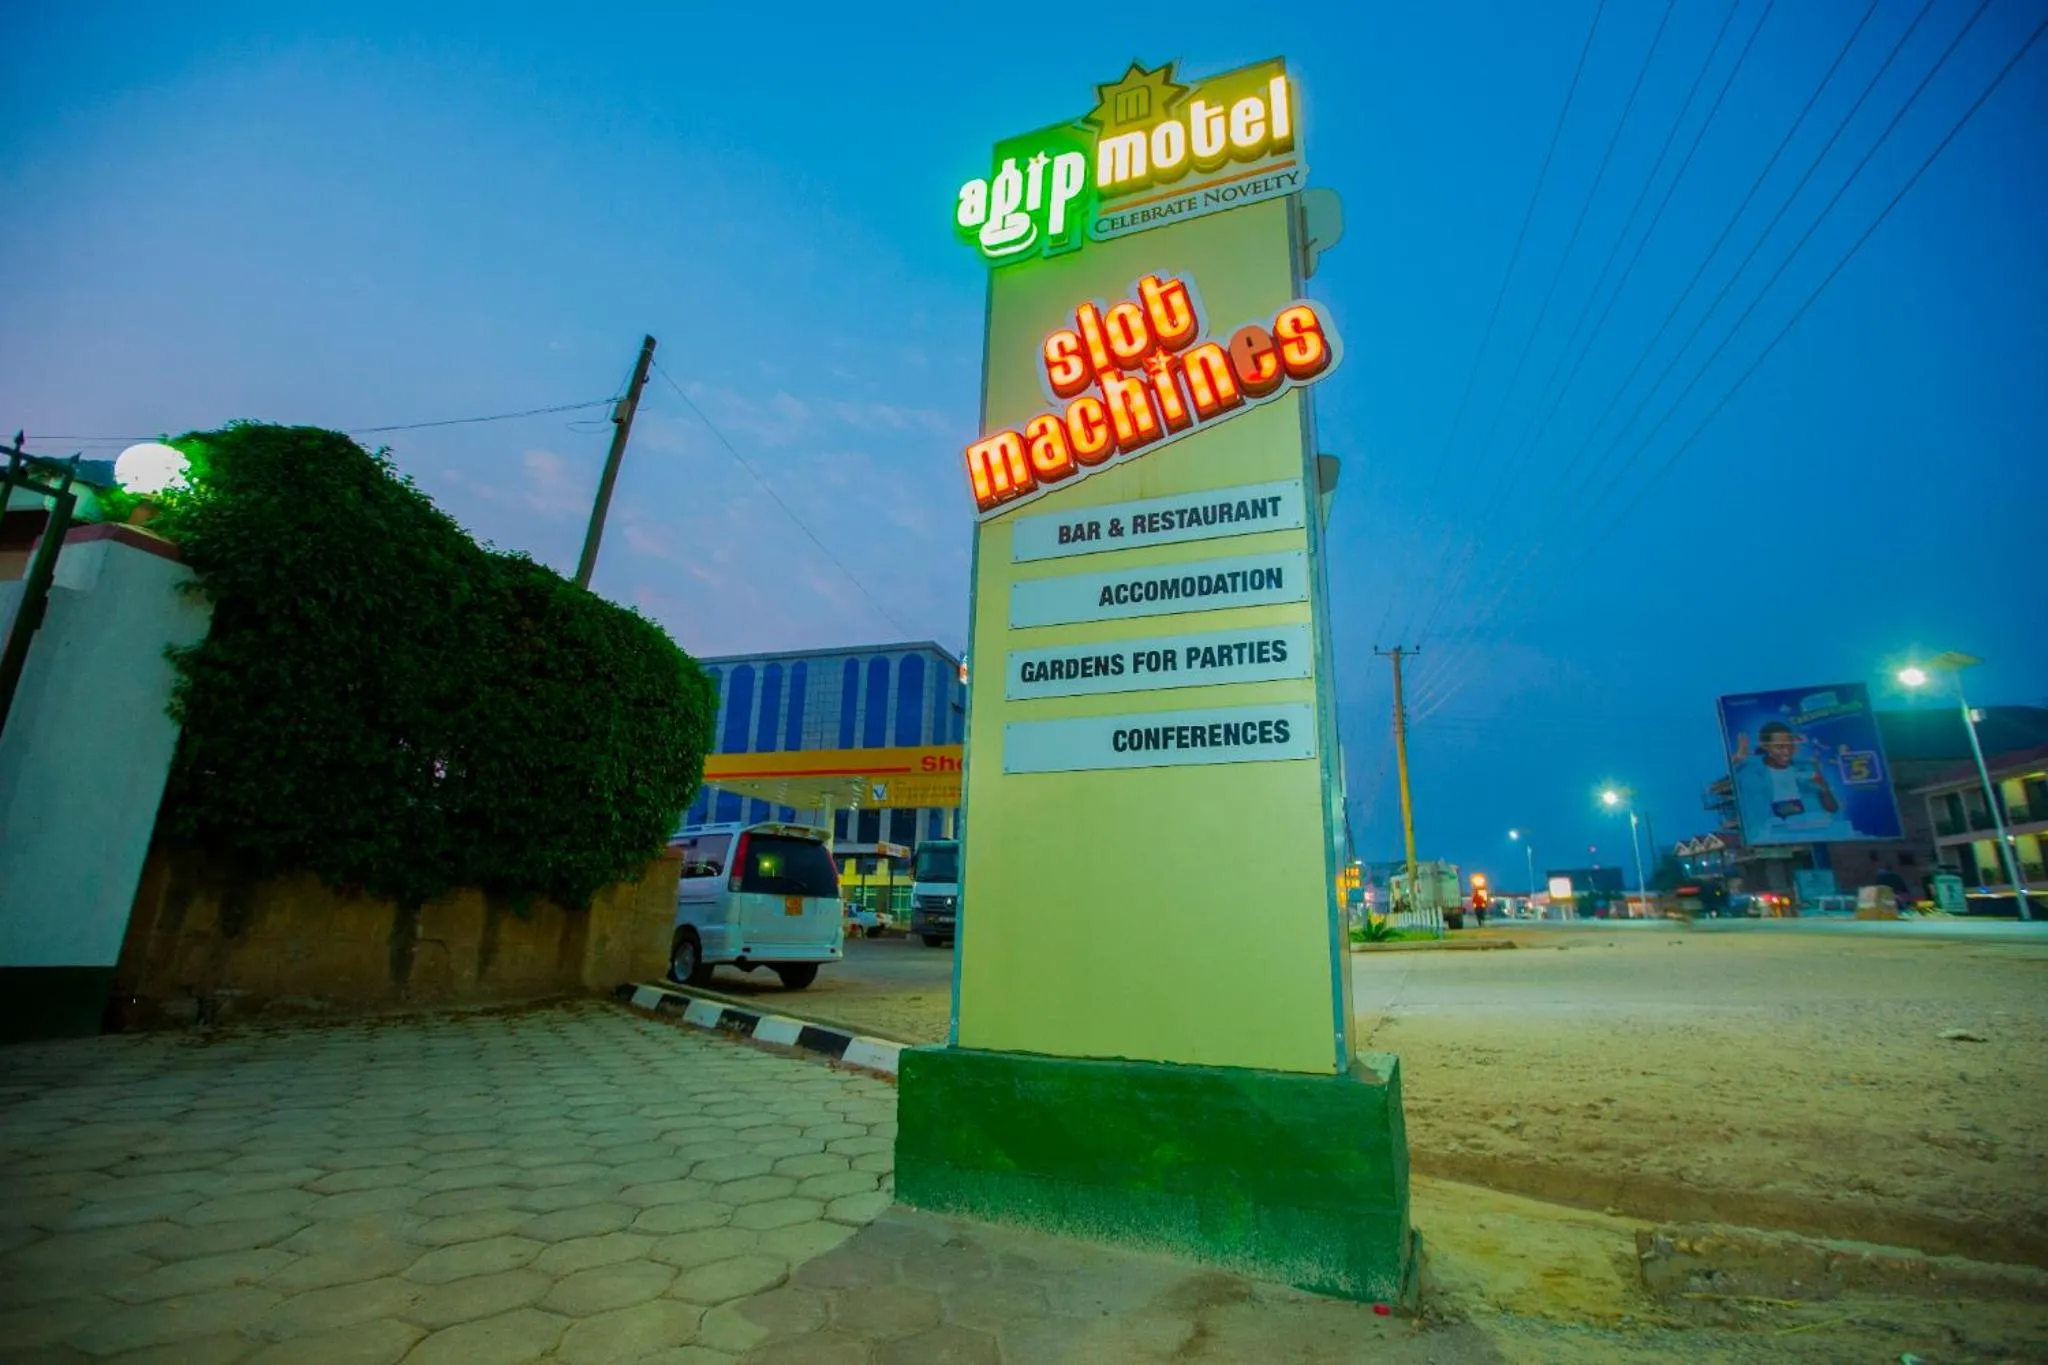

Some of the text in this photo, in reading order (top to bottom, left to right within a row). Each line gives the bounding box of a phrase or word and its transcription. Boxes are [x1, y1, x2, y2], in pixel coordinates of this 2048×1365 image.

[957, 75, 1291, 258] agip motel
[1044, 274, 1198, 394] slot
[966, 304, 1328, 508] machines
[1058, 496, 1282, 545] BAR & RESTAURANT
[1098, 567, 1283, 607] ACCOMODATION
[1020, 639, 1288, 683] GARDENS FOR PARTIES
[1112, 719, 1291, 753] CONFERENCES
